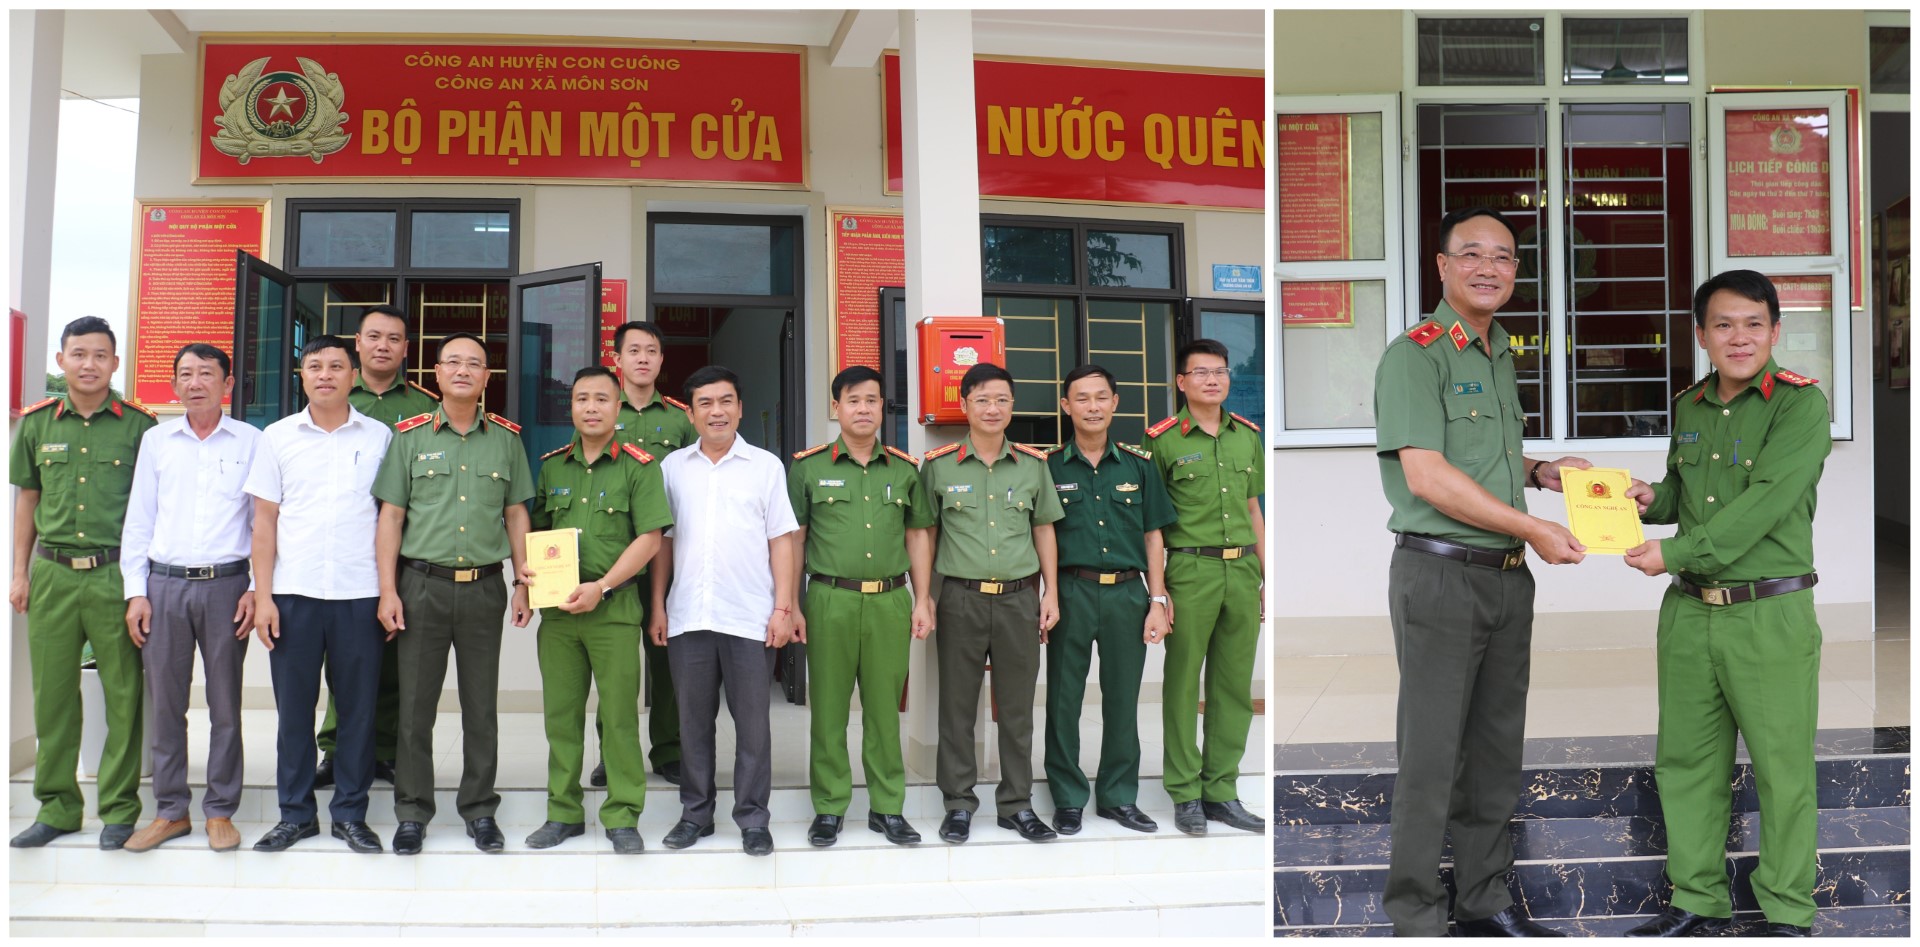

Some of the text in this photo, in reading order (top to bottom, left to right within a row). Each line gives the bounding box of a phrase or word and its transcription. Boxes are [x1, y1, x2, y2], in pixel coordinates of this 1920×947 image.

[404, 51, 681, 71] CÔNG AN HUYỆN CON CUÔNG
[435, 74, 649, 91] CÔNG AN XÃ MÔN SƠN
[1752, 113, 1770, 121] CÔNG
[361, 97, 783, 168] BỘ PHẬN MỘT CỬA
[987, 96, 1265, 170] NƯỚC QUÊN
[1288, 123, 1303, 132] MỘT
[1305, 121, 1319, 131] CỬA
[1729, 161, 1754, 175] LỊCH
[1757, 158, 1783, 173] TIẾP
[1786, 159, 1818, 173] CÔNG
[602, 301, 617, 312] DÂN
